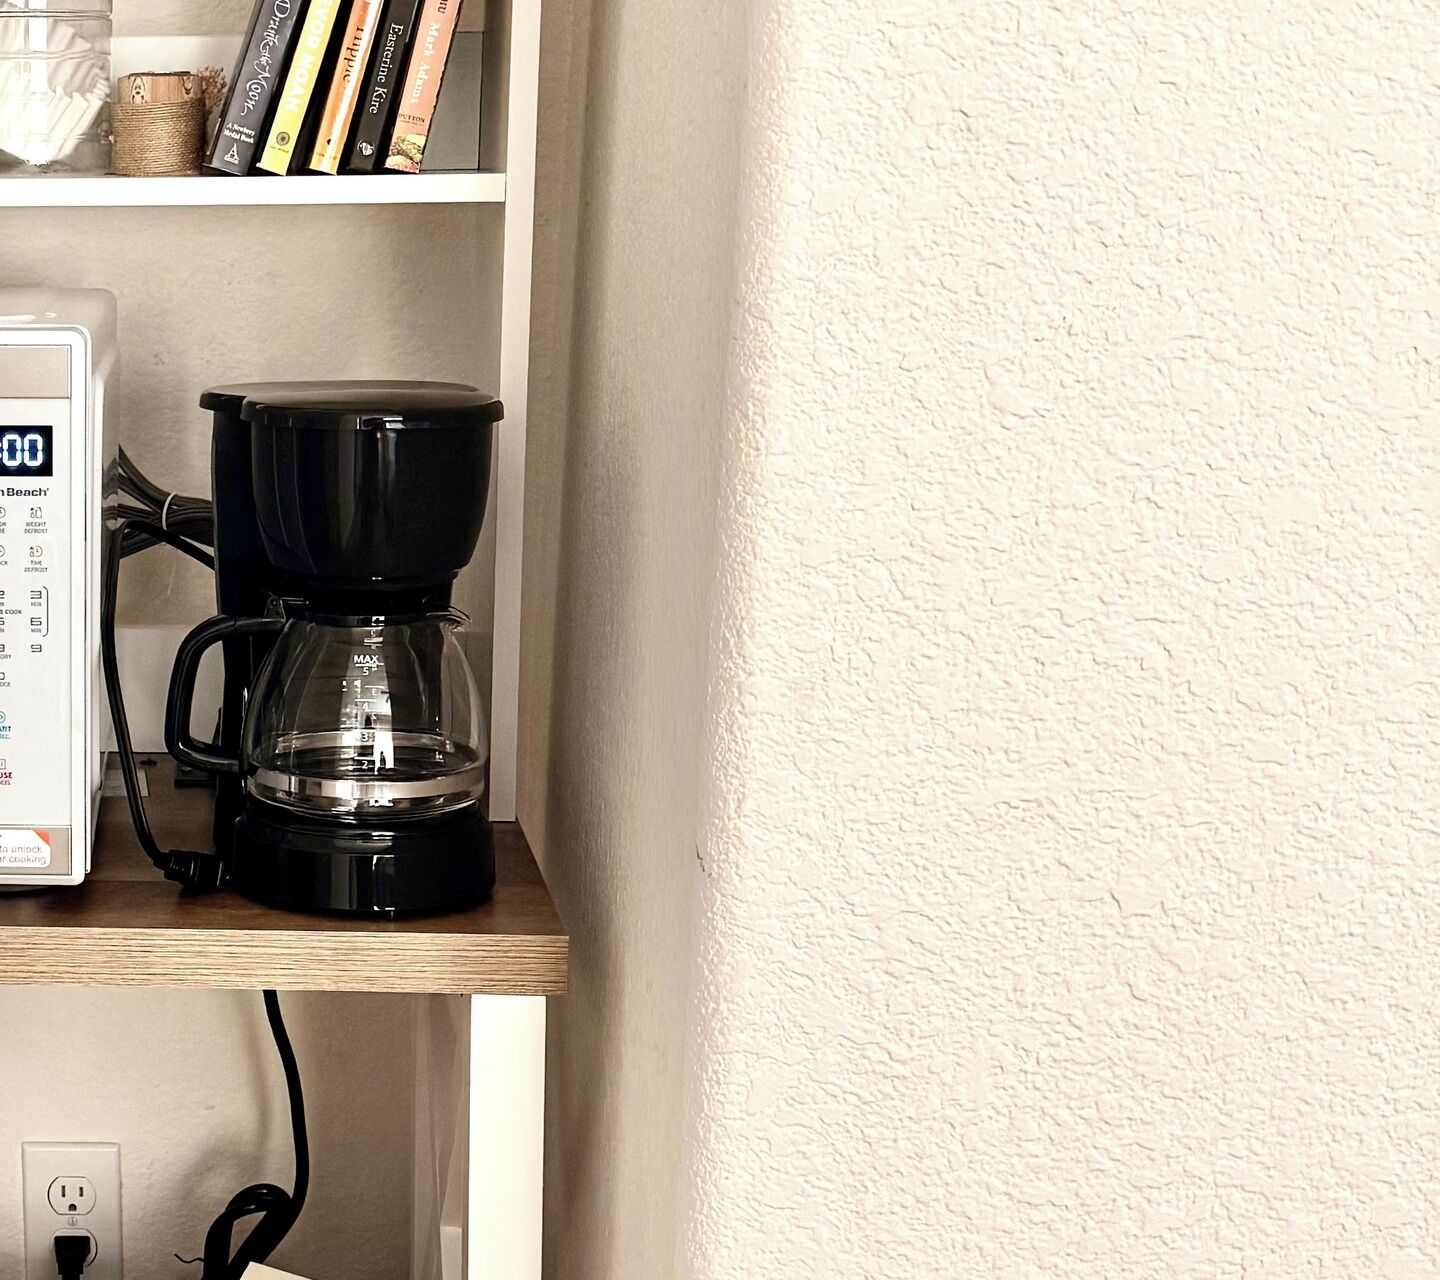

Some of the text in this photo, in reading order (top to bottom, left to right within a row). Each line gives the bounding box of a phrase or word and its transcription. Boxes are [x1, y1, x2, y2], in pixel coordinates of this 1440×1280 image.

[411, 22, 441, 104] Mark Adams
[370, 23, 404, 114] Easterine Kire
[285, 53, 316, 112] NOAH
[241, 61, 272, 116] Moon
[6, 487, 48, 497] Beach
[30, 590, 42, 600] 3
[30, 617, 42, 626] 6
[31, 644, 43, 653] 9
[354, 655, 379, 664] MAX
[363, 667, 370, 677] 5
[0, 845, 9, 854] to
[11, 845, 43, 854] unlock
[8, 855, 47, 866] cooking
